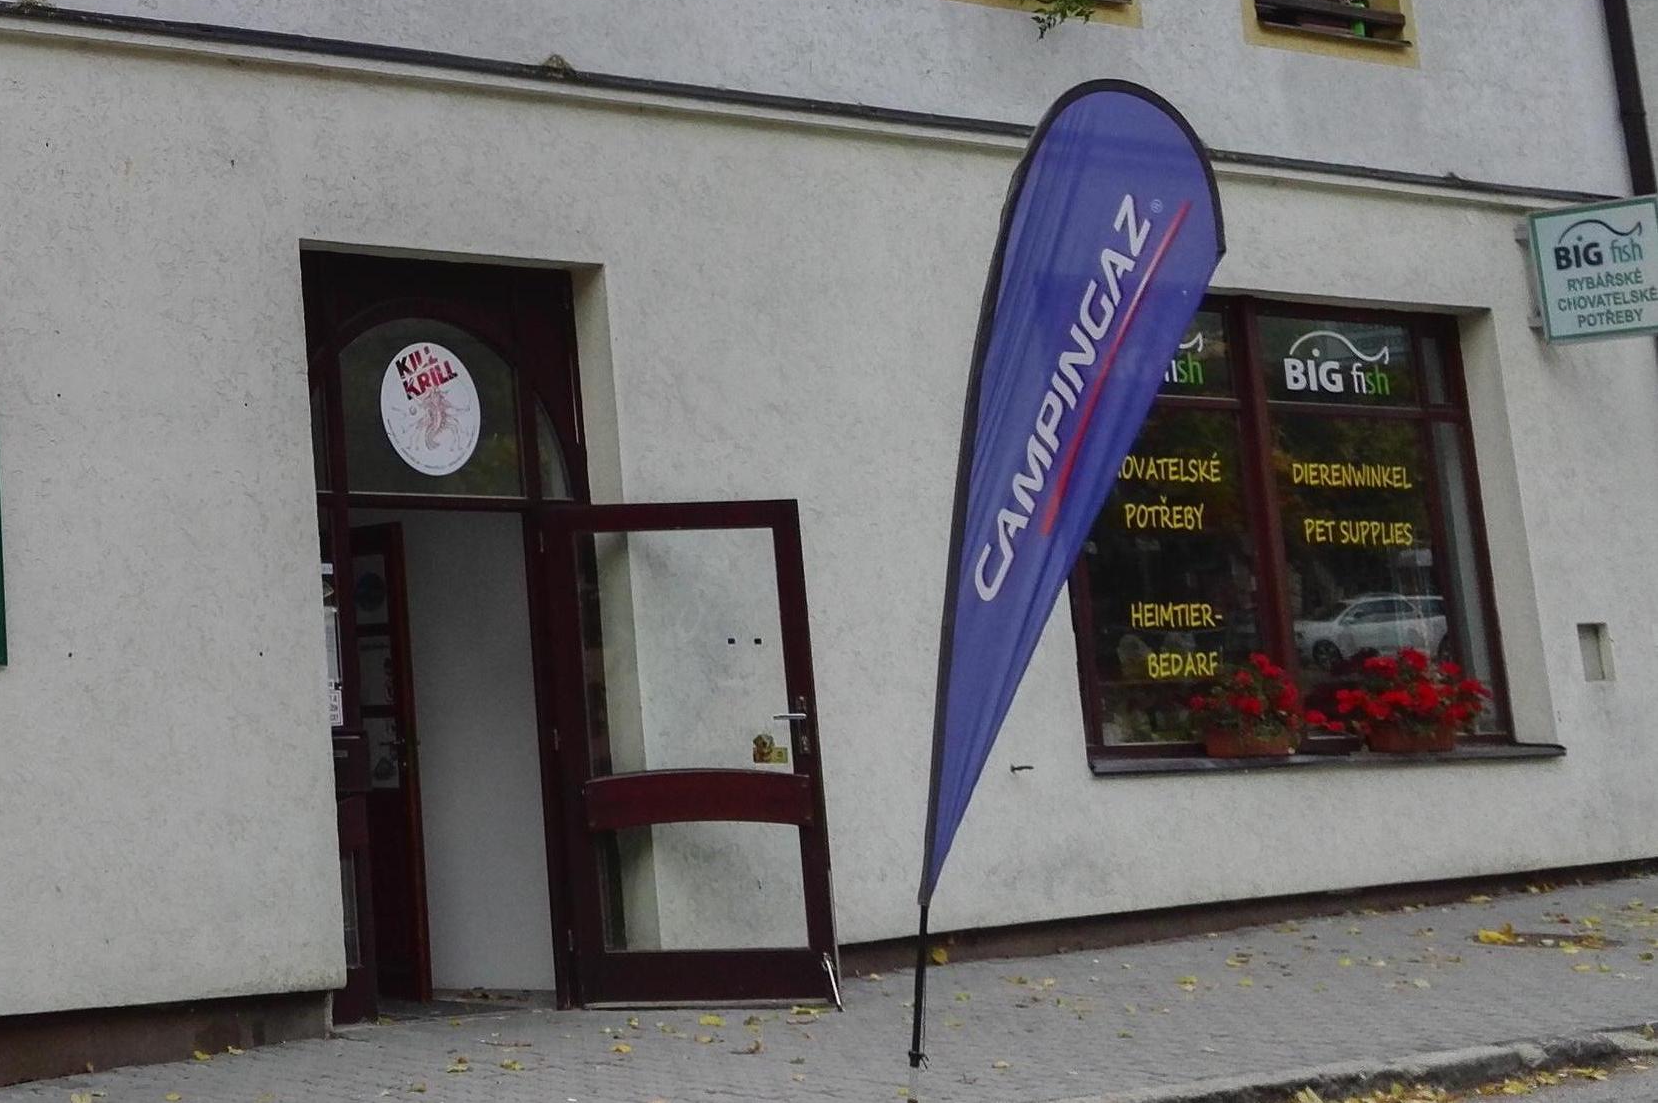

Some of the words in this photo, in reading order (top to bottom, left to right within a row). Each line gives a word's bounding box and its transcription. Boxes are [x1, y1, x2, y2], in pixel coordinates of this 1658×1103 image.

[1554, 241, 1604, 270] BIG
[1609, 237, 1644, 263] fish
[1567, 267, 1644, 291] RYBÁŘSKÉ
[1577, 308, 1644, 328] POTŘEBY
[402, 360, 458, 401] KRILL
[1283, 357, 1344, 393] BIG
[1350, 362, 1390, 395] fish
[974, 194, 1151, 602] CAMPINGAZ
[1292, 462, 1412, 490] DIERENWINKEL
[1124, 495, 1204, 531] POTŘEBY
[1304, 518, 1335, 544] PET
[1340, 522, 1413, 546] SUPPLIES
[1131, 601, 1223, 629] HEIMTIER-
[1147, 651, 1220, 679] BEDARF
